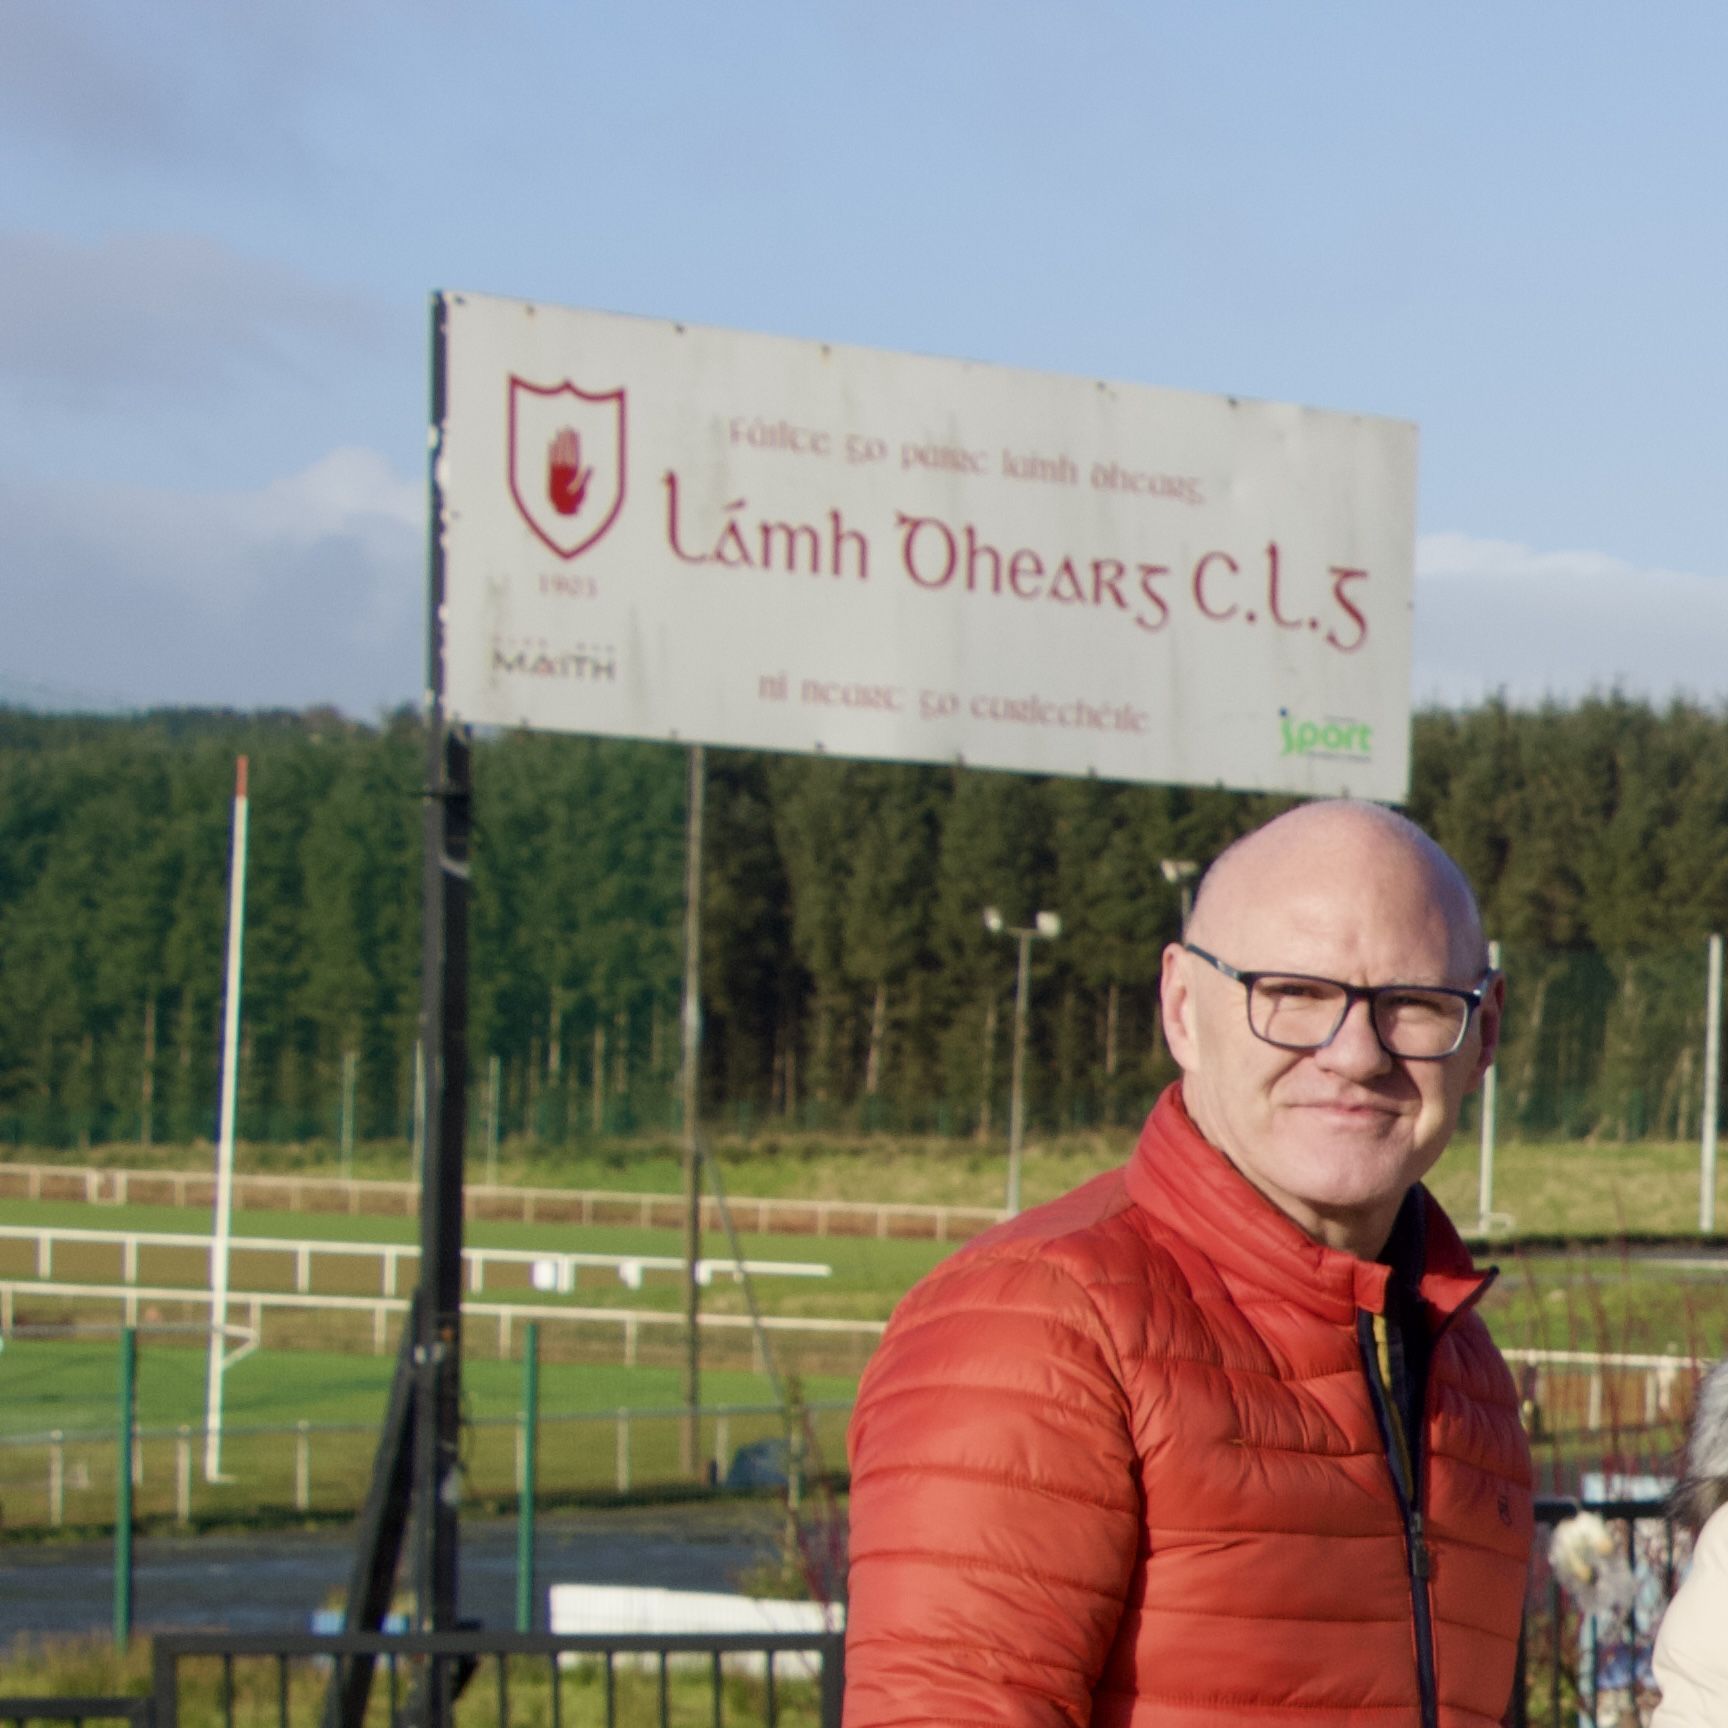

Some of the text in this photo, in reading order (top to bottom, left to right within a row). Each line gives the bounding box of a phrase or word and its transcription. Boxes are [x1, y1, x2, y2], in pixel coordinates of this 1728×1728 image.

[846, 432, 888, 466] go
[662, 470, 867, 580] Lámh
[895, 508, 1171, 632] Dhearg
[918, 689, 960, 721] go
